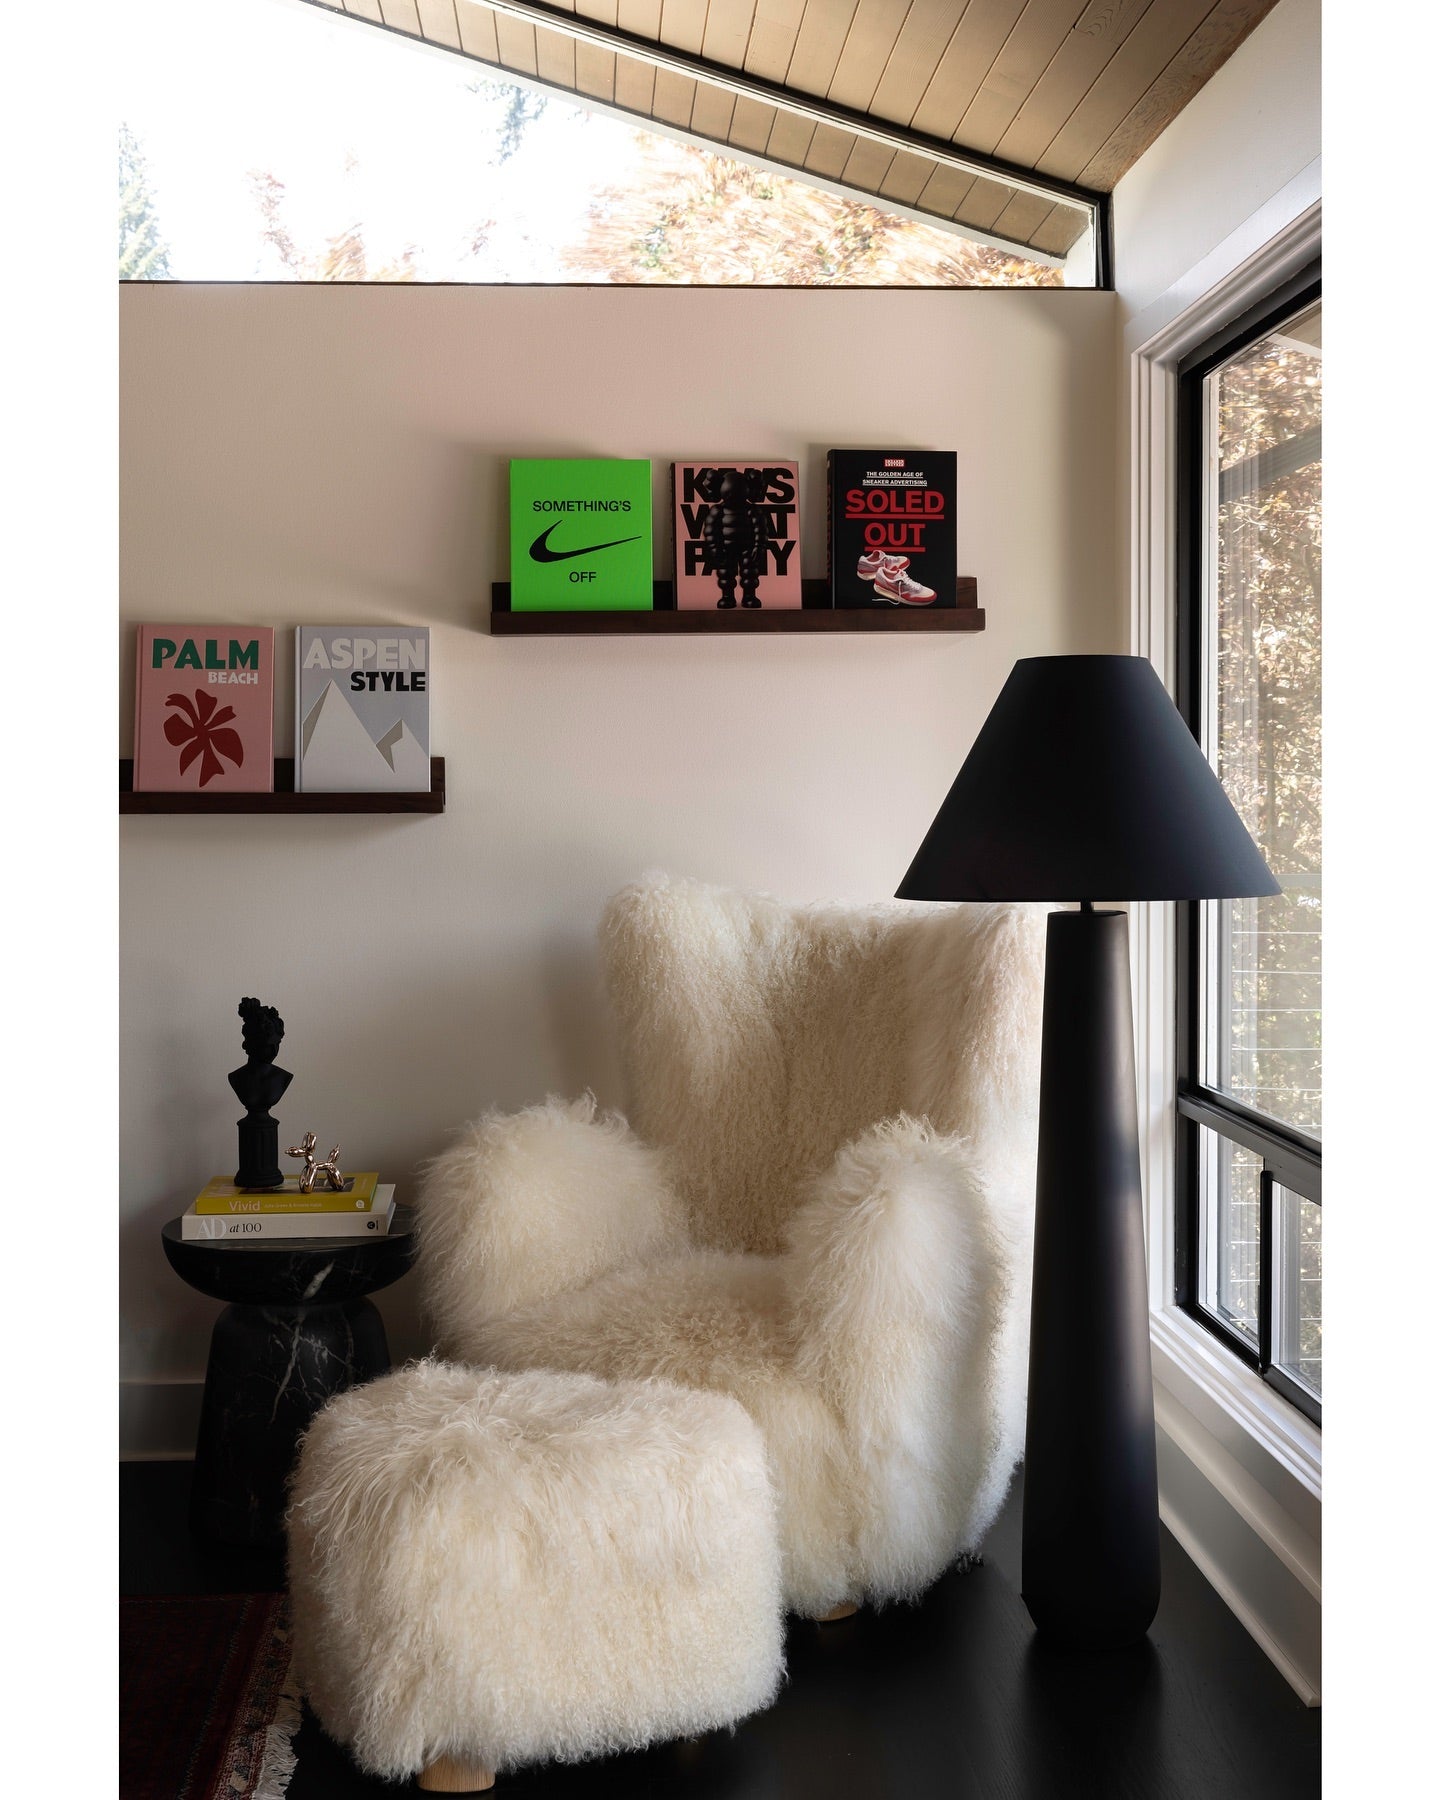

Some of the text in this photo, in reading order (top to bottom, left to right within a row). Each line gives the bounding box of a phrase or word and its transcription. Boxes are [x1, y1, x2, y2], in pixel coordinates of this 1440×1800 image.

[532, 500, 632, 512] SOMETHING'S
[845, 489, 945, 513] SOLED
[864, 522, 926, 546] OUT
[569, 571, 597, 583] OFF
[152, 638, 259, 670] PALM
[303, 637, 426, 670] ASPEN
[207, 671, 259, 685] BEACH
[350, 671, 426, 692] STYLE
[229, 1200, 261, 1211] Vivid
[196, 1217, 262, 1239] AD at 100
